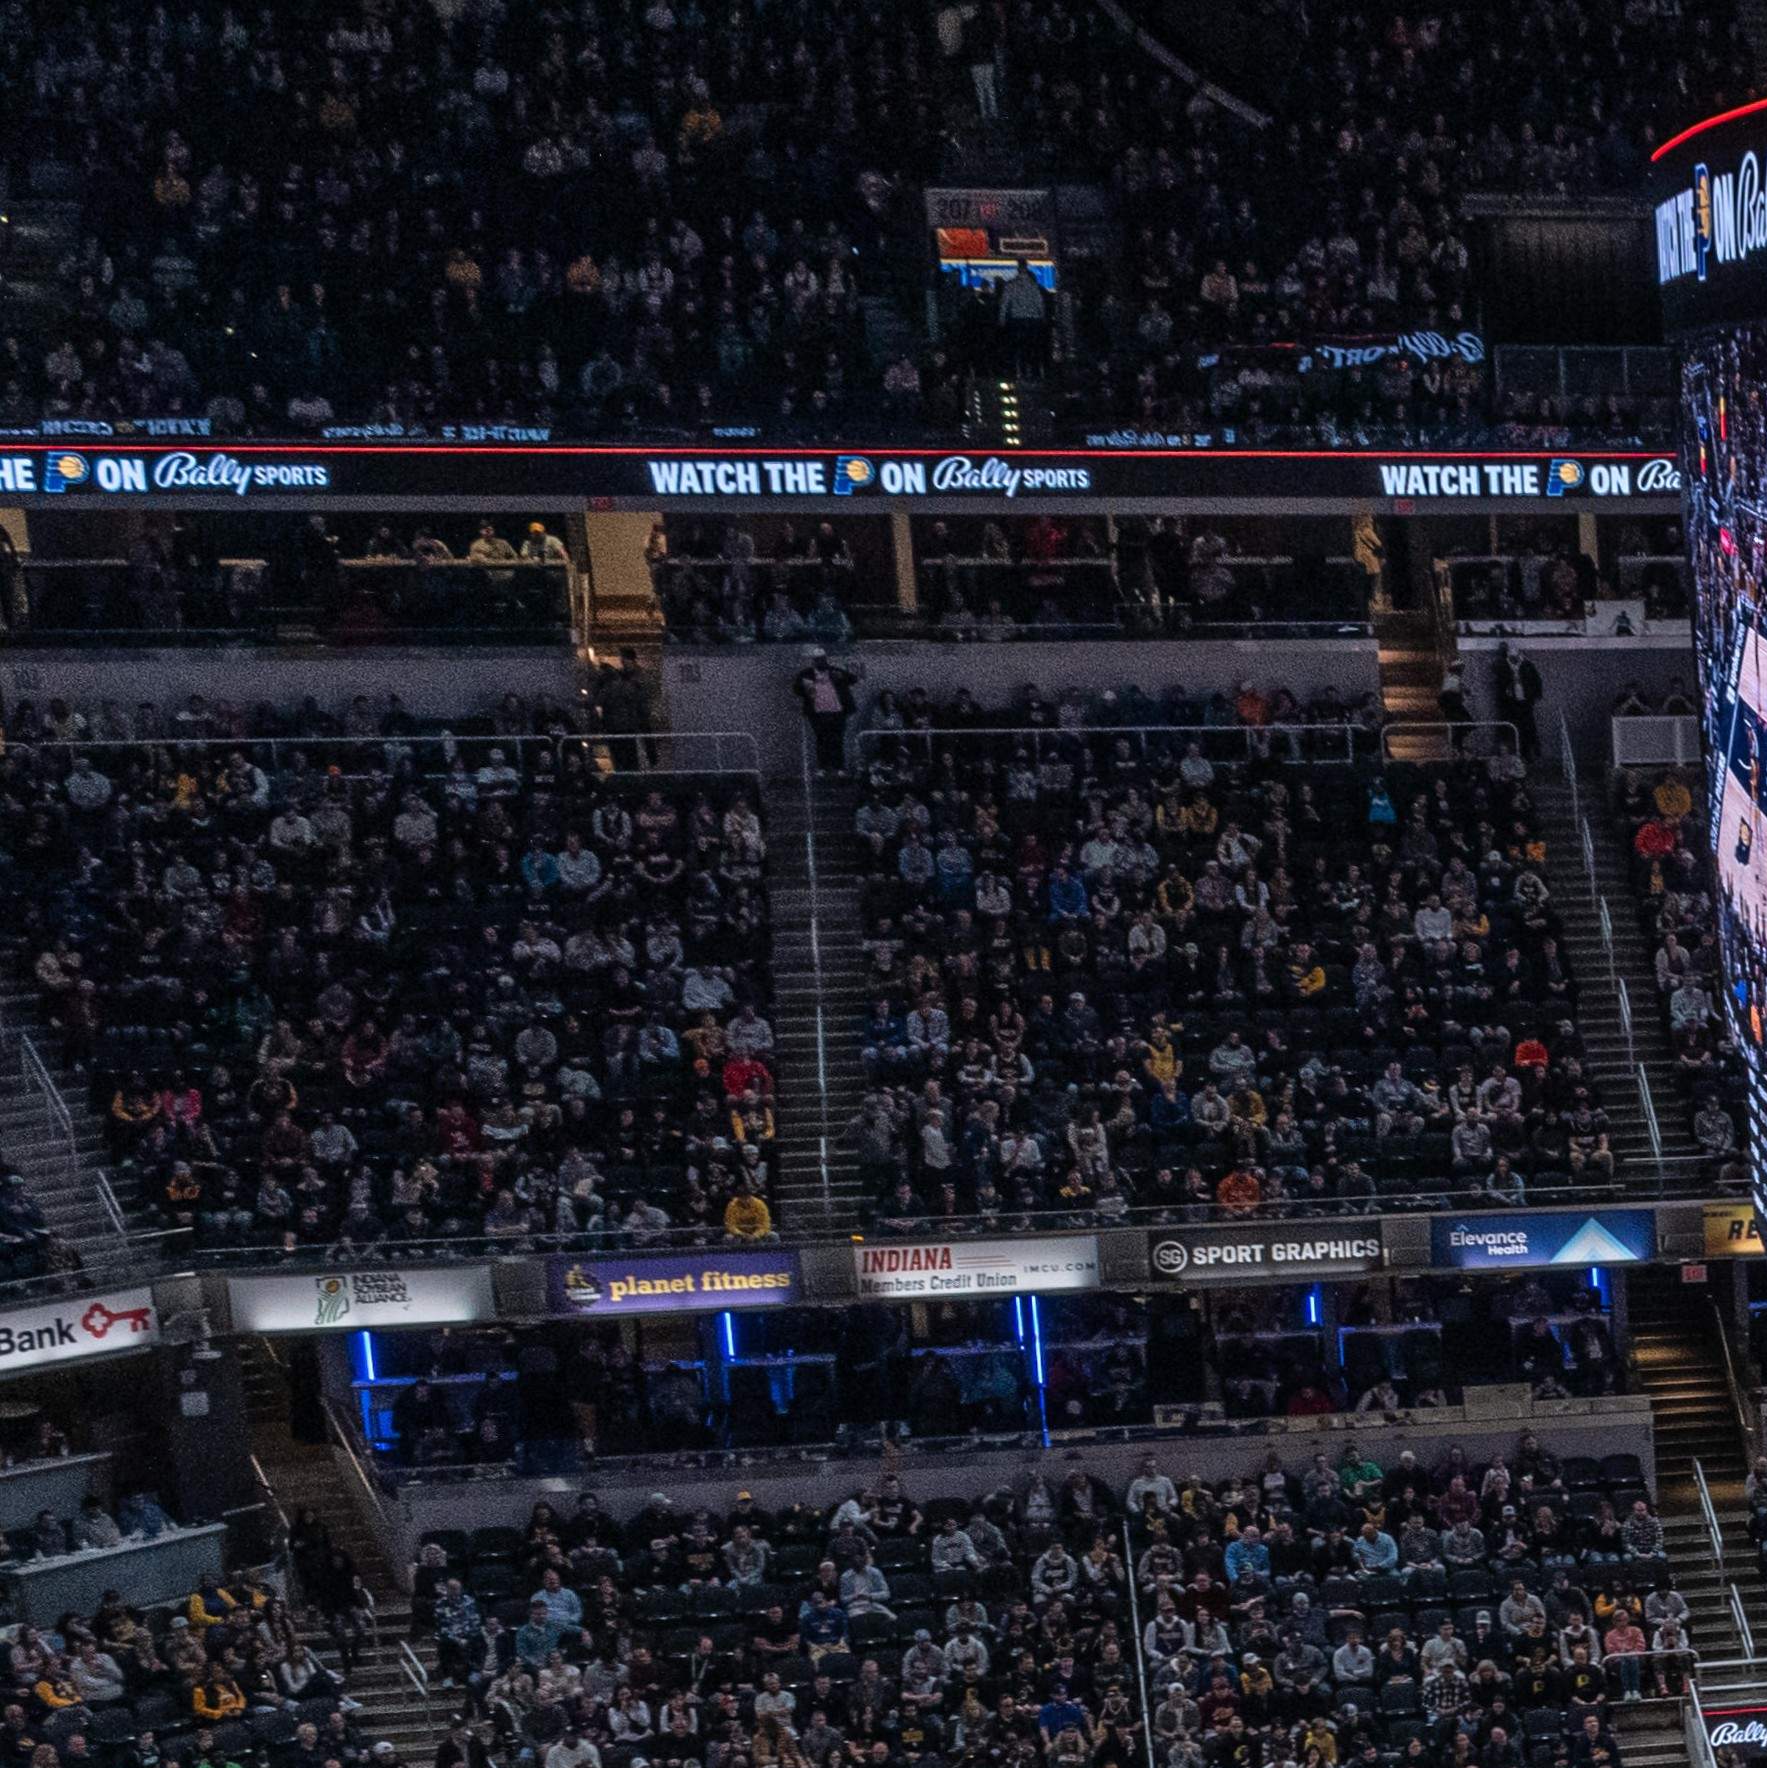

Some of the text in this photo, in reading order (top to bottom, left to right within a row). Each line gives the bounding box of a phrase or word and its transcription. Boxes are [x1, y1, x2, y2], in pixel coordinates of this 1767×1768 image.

[1714, 174, 1736, 263] ON
[98, 452, 328, 495] ON Bally SPORTS
[648, 457, 1090, 497] WATCH THE ON Bally SPORTS
[1379, 465, 1480, 495] WATCH
[1484, 466, 1540, 495] THE
[1590, 466, 1630, 495] ON
[862, 1247, 952, 1273] INDIANA
[1191, 1240, 1379, 1265] SPORT GRAPHICS
[1488, 1244, 1528, 1255] Health
[610, 1270, 790, 1302] planet fitness
[861, 1272, 1017, 1293] Members Credit Union
